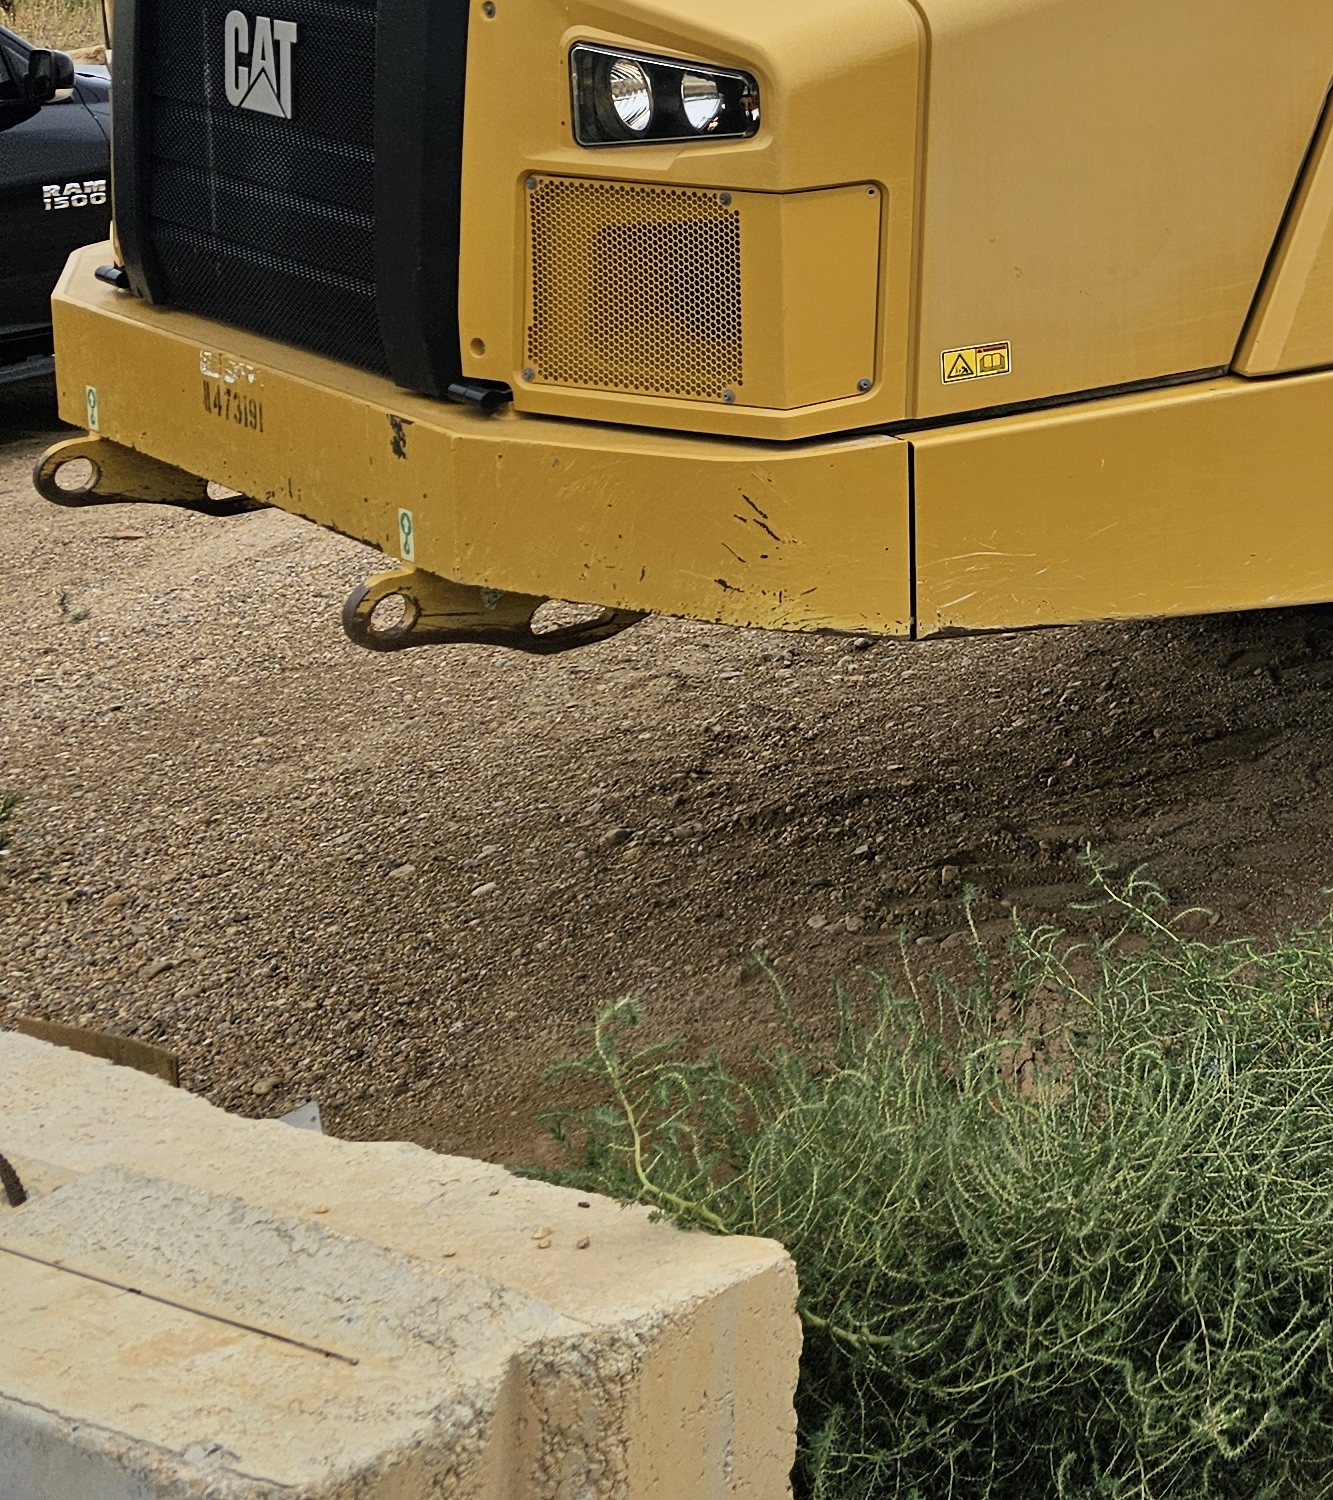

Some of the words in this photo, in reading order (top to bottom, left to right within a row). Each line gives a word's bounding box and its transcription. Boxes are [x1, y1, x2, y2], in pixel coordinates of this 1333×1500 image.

[224, 9, 298, 120] CAT
[42, 179, 107, 199] RAM
[43, 192, 107, 211] 1500
